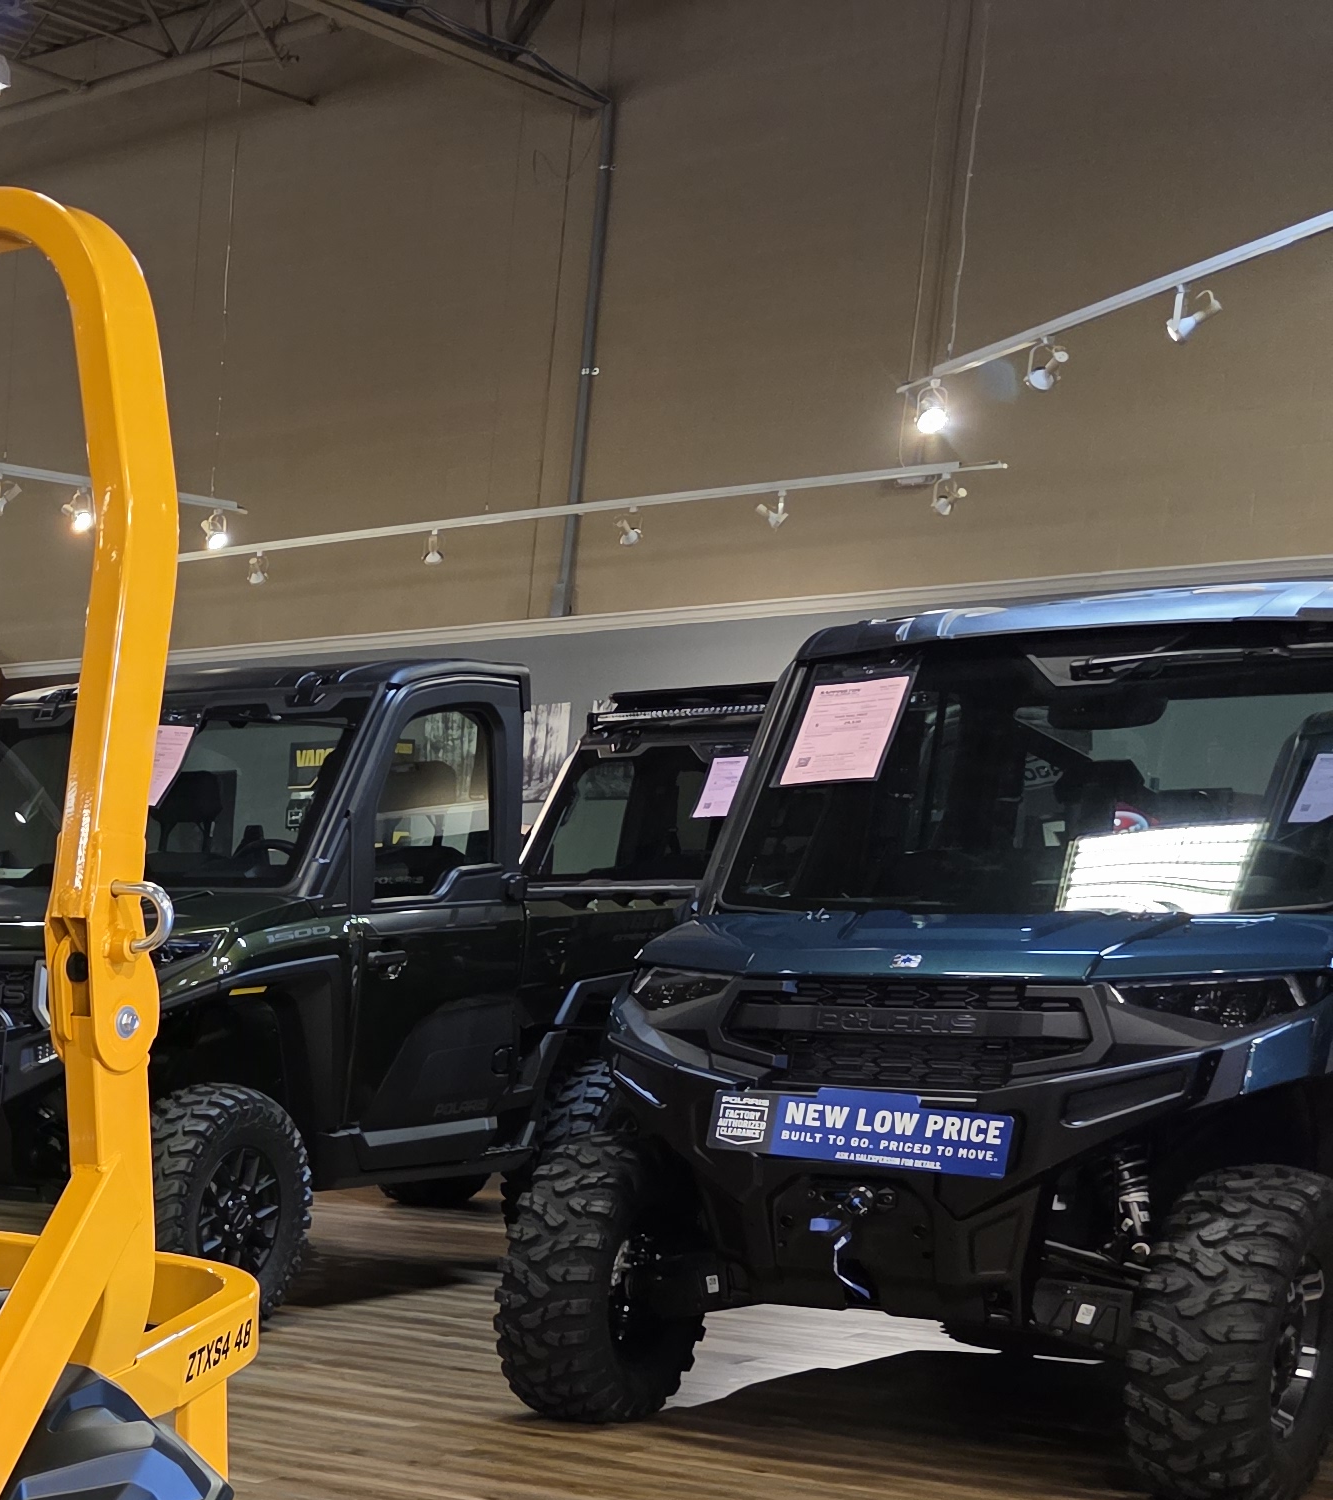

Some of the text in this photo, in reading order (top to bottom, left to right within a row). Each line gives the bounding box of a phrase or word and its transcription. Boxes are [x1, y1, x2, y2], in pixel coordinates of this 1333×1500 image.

[816, 1010, 976, 1033] POLARIS
[722, 1096, 769, 1106] POLARIS
[725, 1109, 761, 1120] FACTORY
[717, 1118, 766, 1130] AUTHORIZED
[784, 1102, 1005, 1145] NEW LOW PRICE
[720, 1127, 760, 1138] CLEARANCE
[781, 1130, 998, 1162] BUILT TO GO. PRICED TO MOVE.
[835, 1152, 849, 1160] ASK
[185, 1319, 252, 1383] ZTXS4 48
